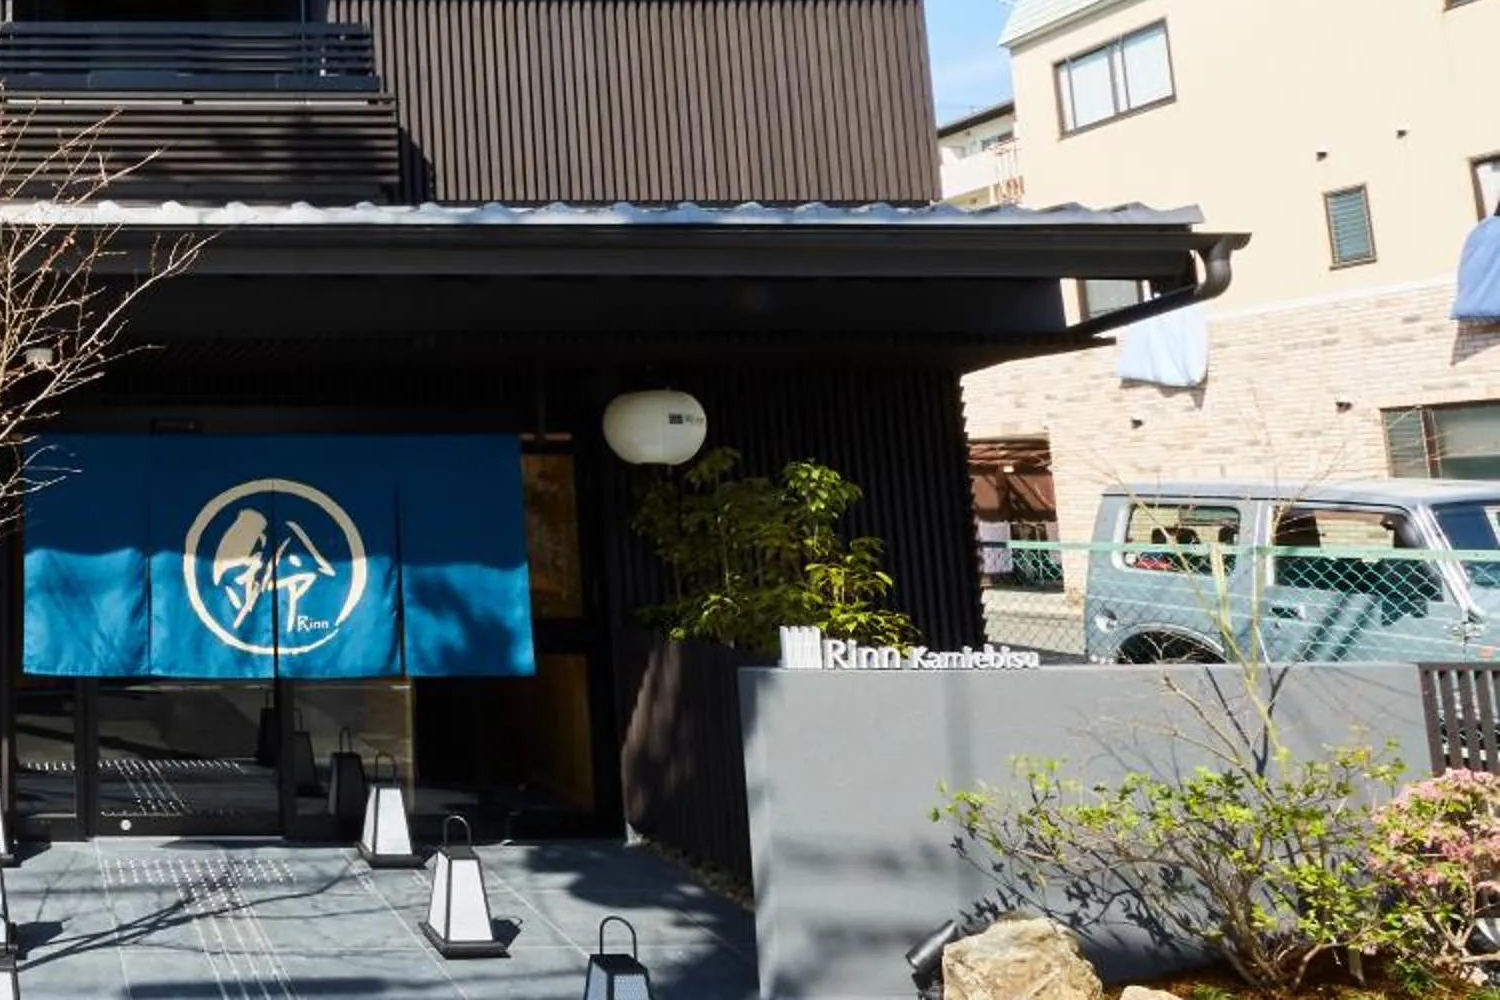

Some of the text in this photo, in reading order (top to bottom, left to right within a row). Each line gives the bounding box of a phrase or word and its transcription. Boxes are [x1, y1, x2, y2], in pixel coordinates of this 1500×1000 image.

[297, 615, 330, 632] Rinn
[823, 638, 1040, 669] Rinn Kamiebisu
